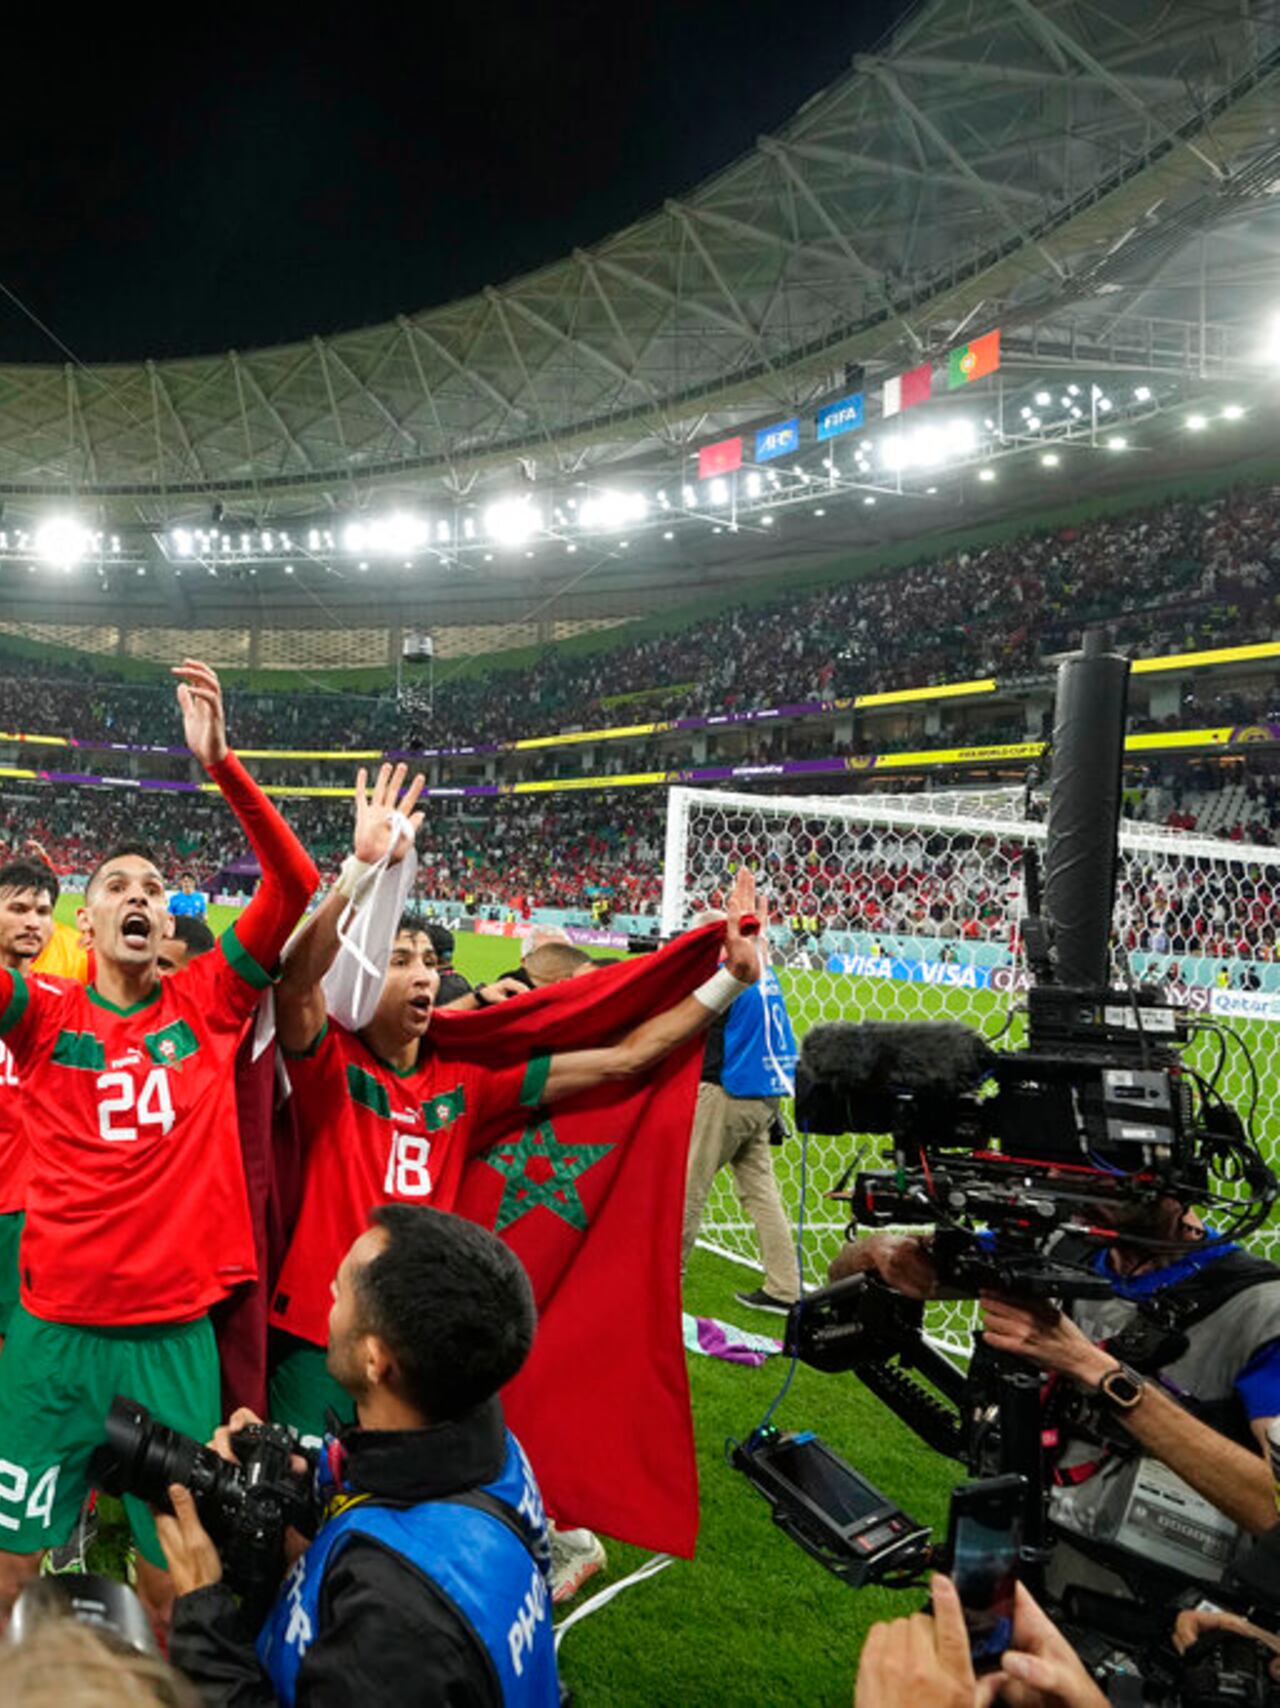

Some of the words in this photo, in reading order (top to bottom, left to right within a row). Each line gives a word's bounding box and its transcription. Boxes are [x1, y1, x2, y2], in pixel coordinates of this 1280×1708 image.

[824, 406, 856, 430] FIFA
[761, 429, 793, 454] AFC
[842, 954, 893, 979] VISA
[921, 962, 977, 988] VISA
[96, 1068, 176, 1142] 24
[384, 1129, 433, 1196] 18
